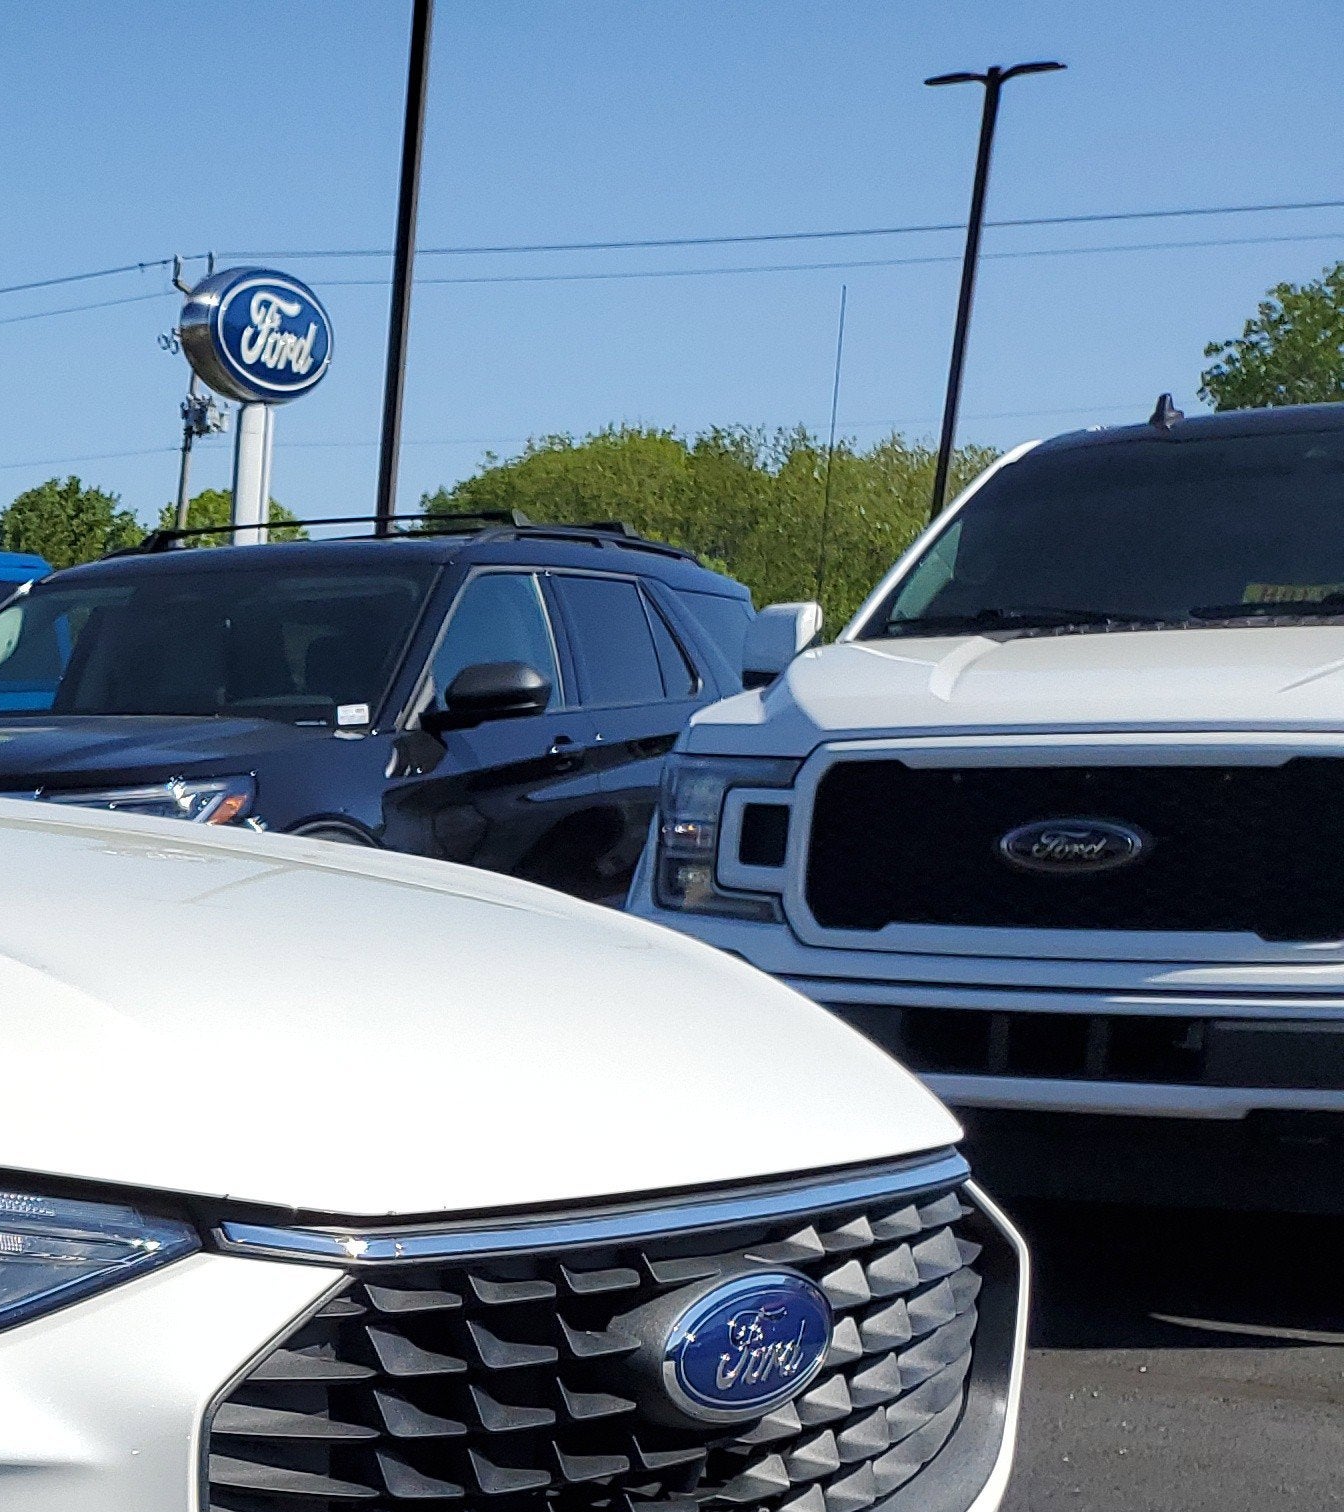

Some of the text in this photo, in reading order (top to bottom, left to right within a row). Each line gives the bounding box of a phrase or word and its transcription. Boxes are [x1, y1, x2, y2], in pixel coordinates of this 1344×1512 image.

[241, 291, 318, 375] Ford
[1032, 830, 1107, 859] Ford
[716, 1306, 807, 1391] Ford
